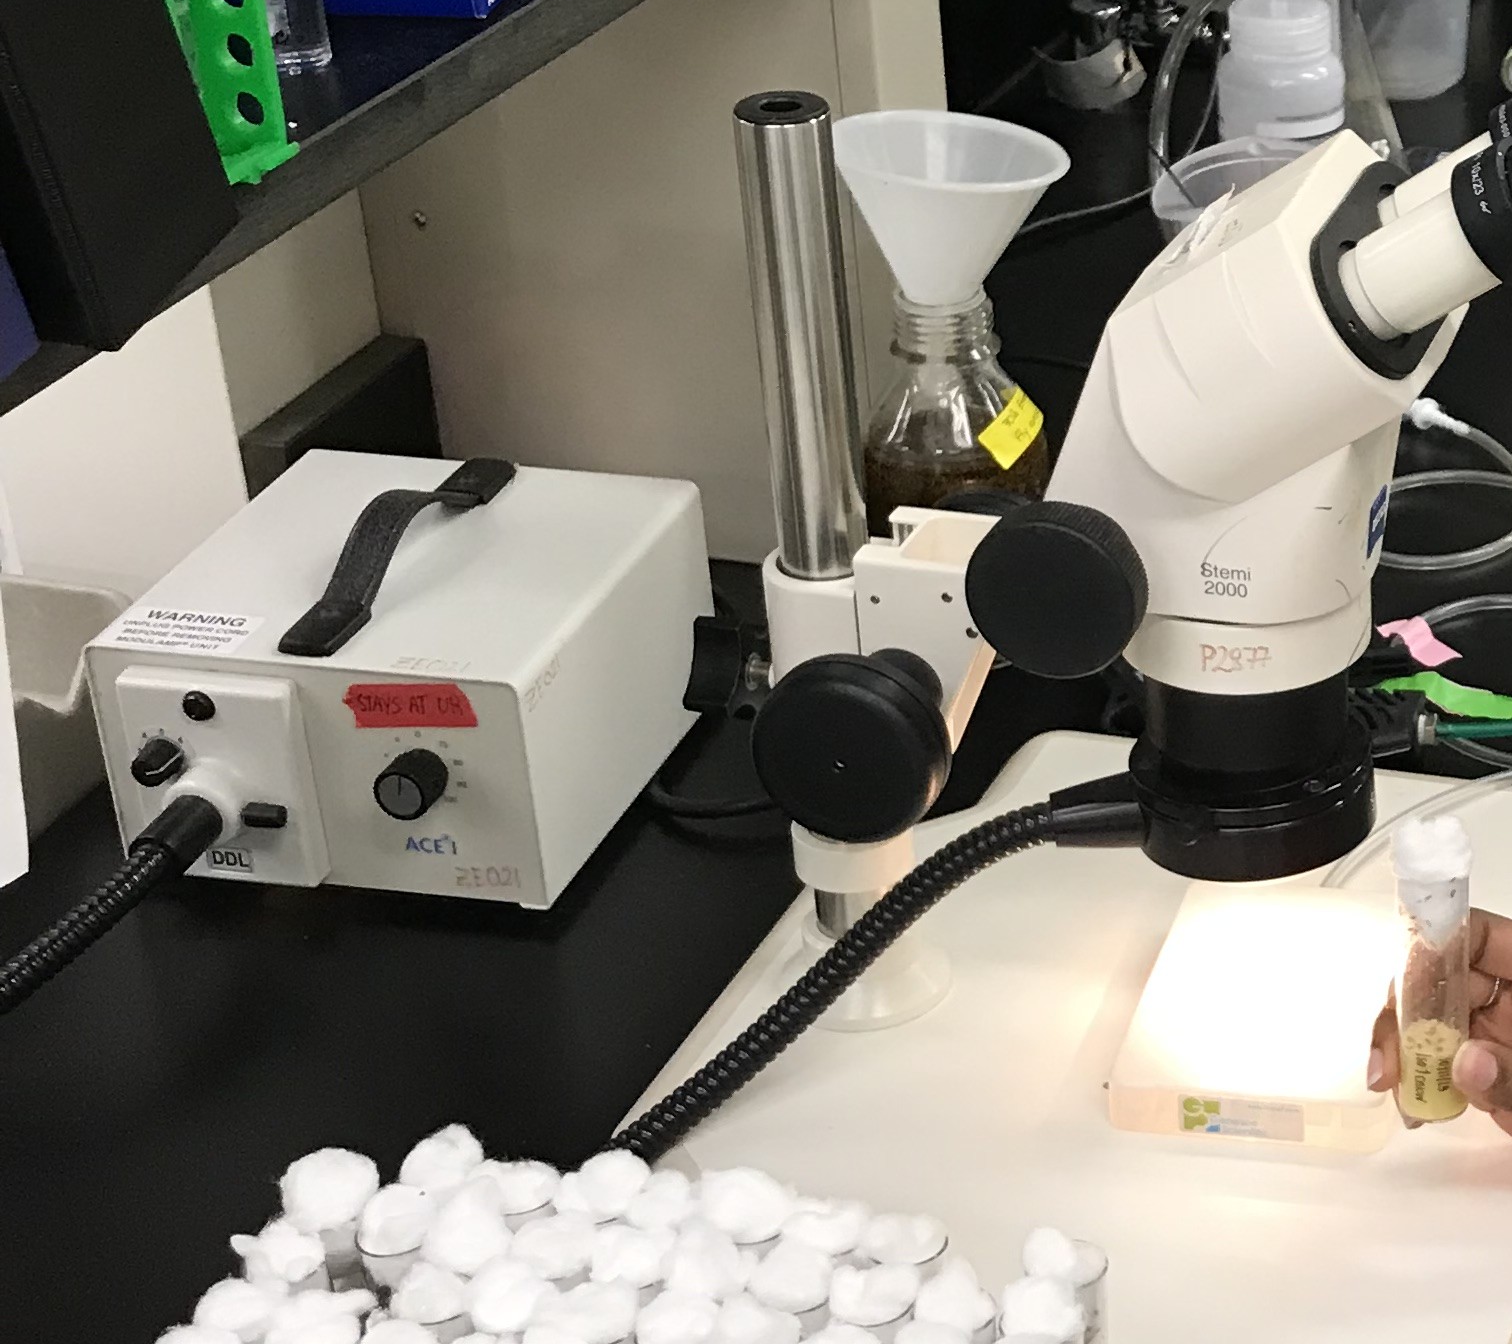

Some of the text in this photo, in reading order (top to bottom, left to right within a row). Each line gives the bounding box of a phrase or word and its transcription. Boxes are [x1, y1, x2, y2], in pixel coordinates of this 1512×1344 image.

[1200, 562, 1252, 582] Stemi
[1203, 580, 1249, 598] 2000
[147, 609, 247, 627] WARNING
[121, 627, 233, 643] BEFORE REMOVING
[122, 619, 249, 636] UNPLUG POWER CORD
[189, 642, 219, 650] UNIT
[356, 693, 402, 715] STAYS
[408, 694, 428, 715] AT
[211, 849, 251, 868] DDL
